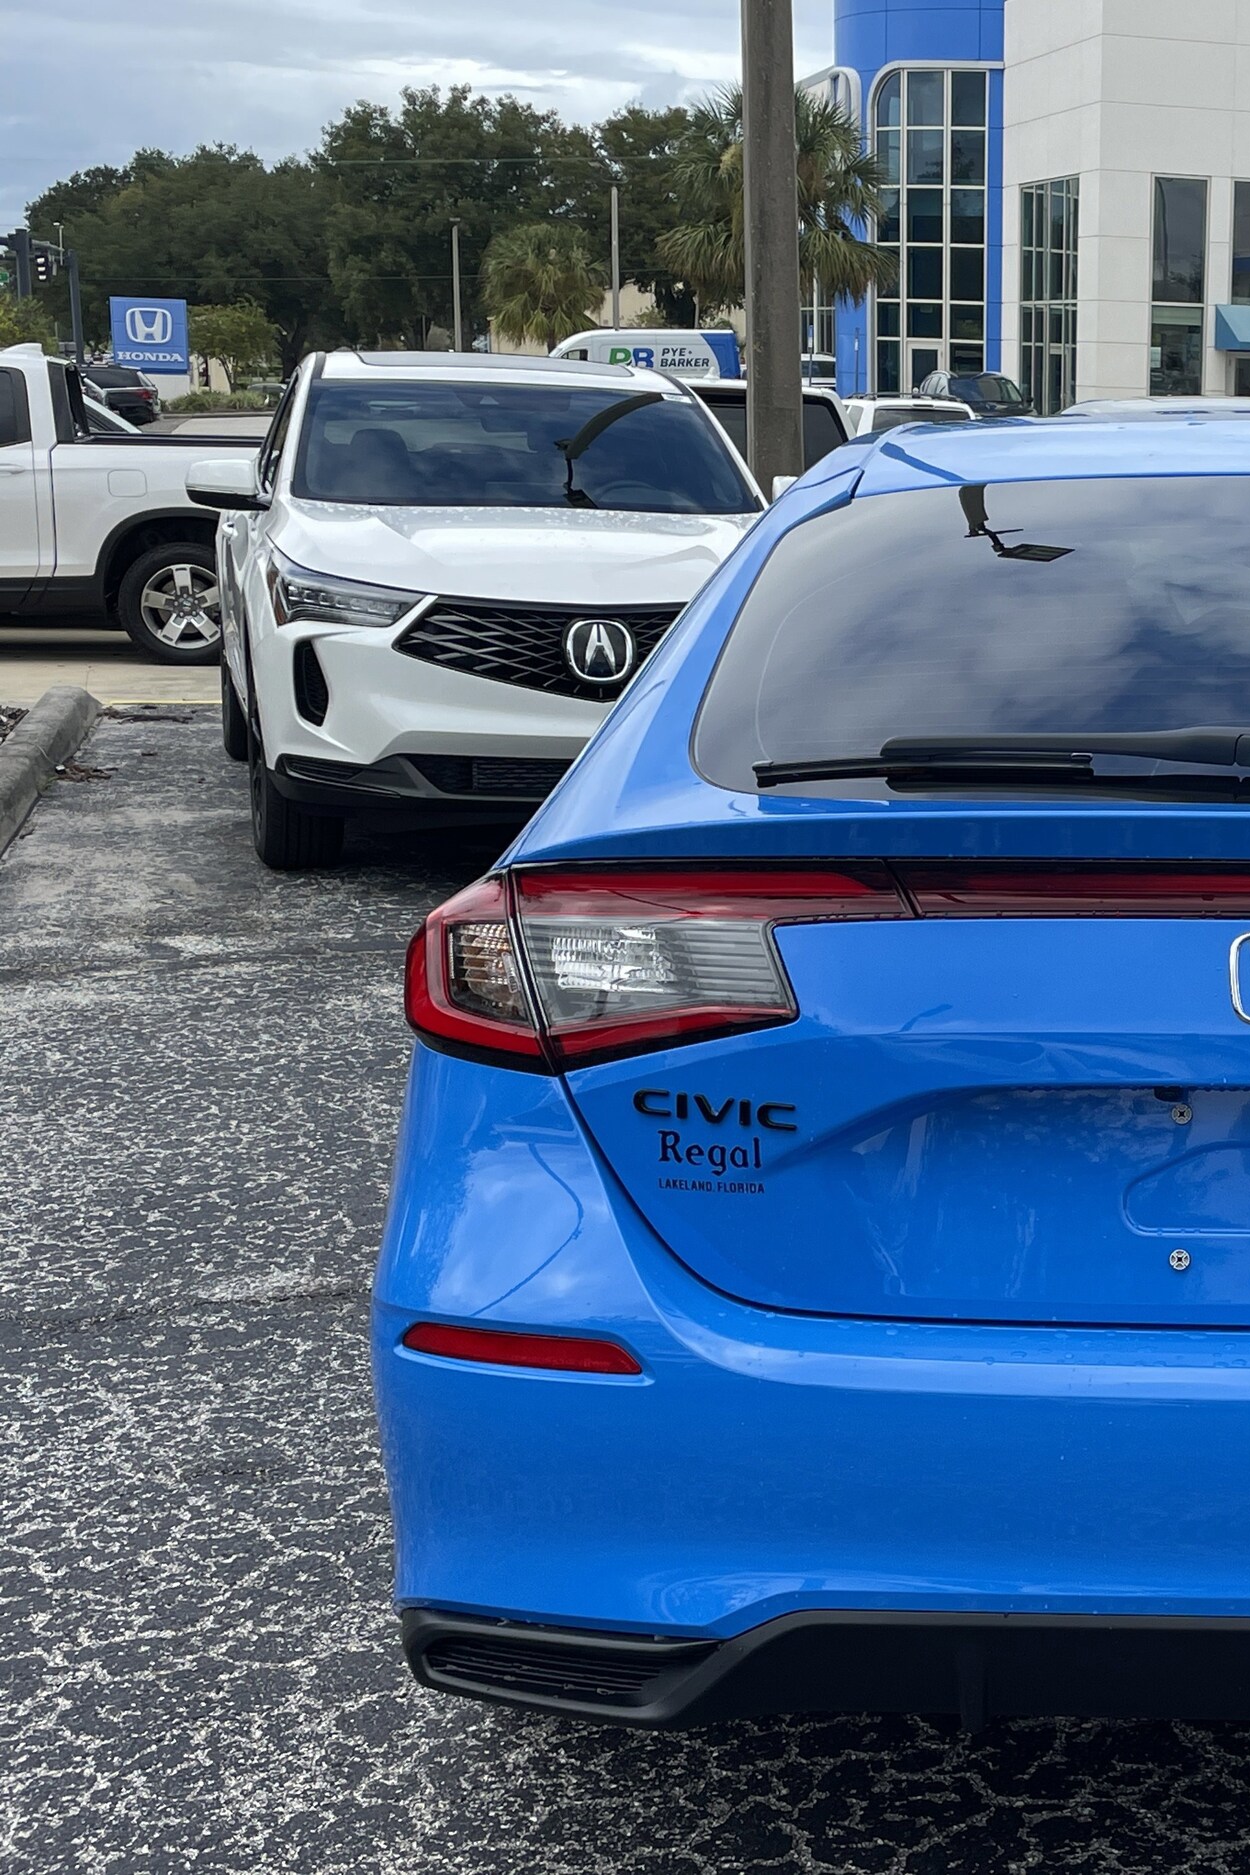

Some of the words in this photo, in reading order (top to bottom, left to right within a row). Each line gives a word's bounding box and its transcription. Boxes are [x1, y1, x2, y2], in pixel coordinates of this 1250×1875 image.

[117, 351, 184, 362] HONDA
[660, 358, 709, 368] BARKER
[633, 1088, 798, 1132] CIVIC
[658, 1129, 762, 1176] Regal
[717, 1181, 765, 1194] FLORIDA
